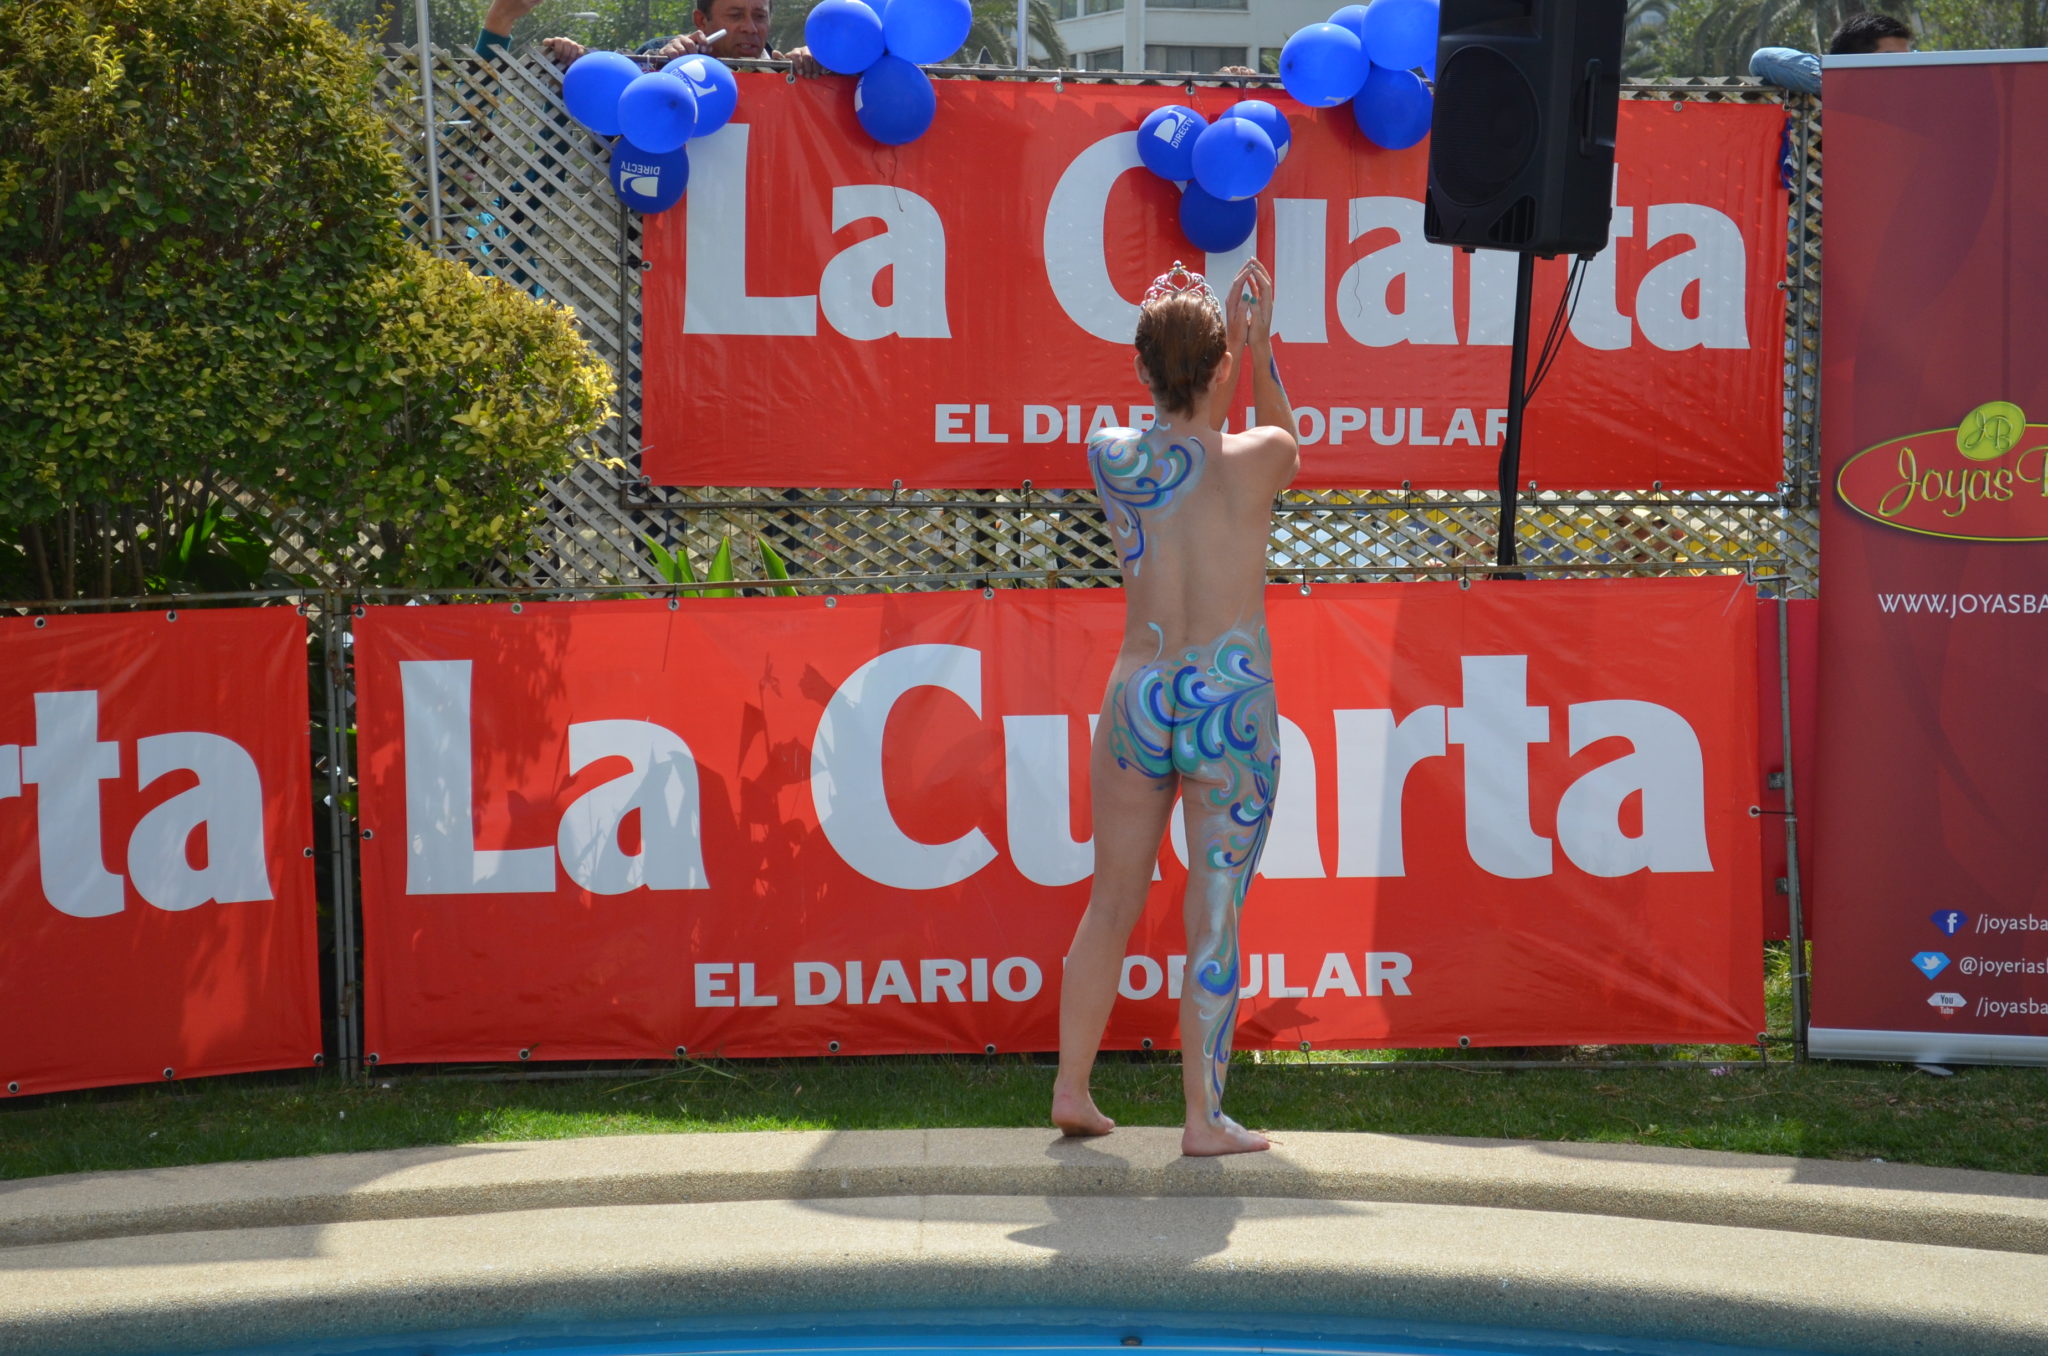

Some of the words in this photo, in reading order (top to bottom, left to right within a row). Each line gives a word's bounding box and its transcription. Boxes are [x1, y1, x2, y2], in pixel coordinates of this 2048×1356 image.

[1171, 117, 1195, 149] DIRECTV
[620, 161, 661, 175] DIRECTV
[683, 123, 953, 341] La
[935, 404, 1009, 443] EL
[1246, 406, 1509, 446] OPULAR
[1877, 447, 2014, 517] Joyas
[399, 660, 710, 895] La
[694, 963, 778, 1008] EL
[794, 957, 1043, 1006] DIARIO
[1959, 956, 2048, 977] @joyerias
